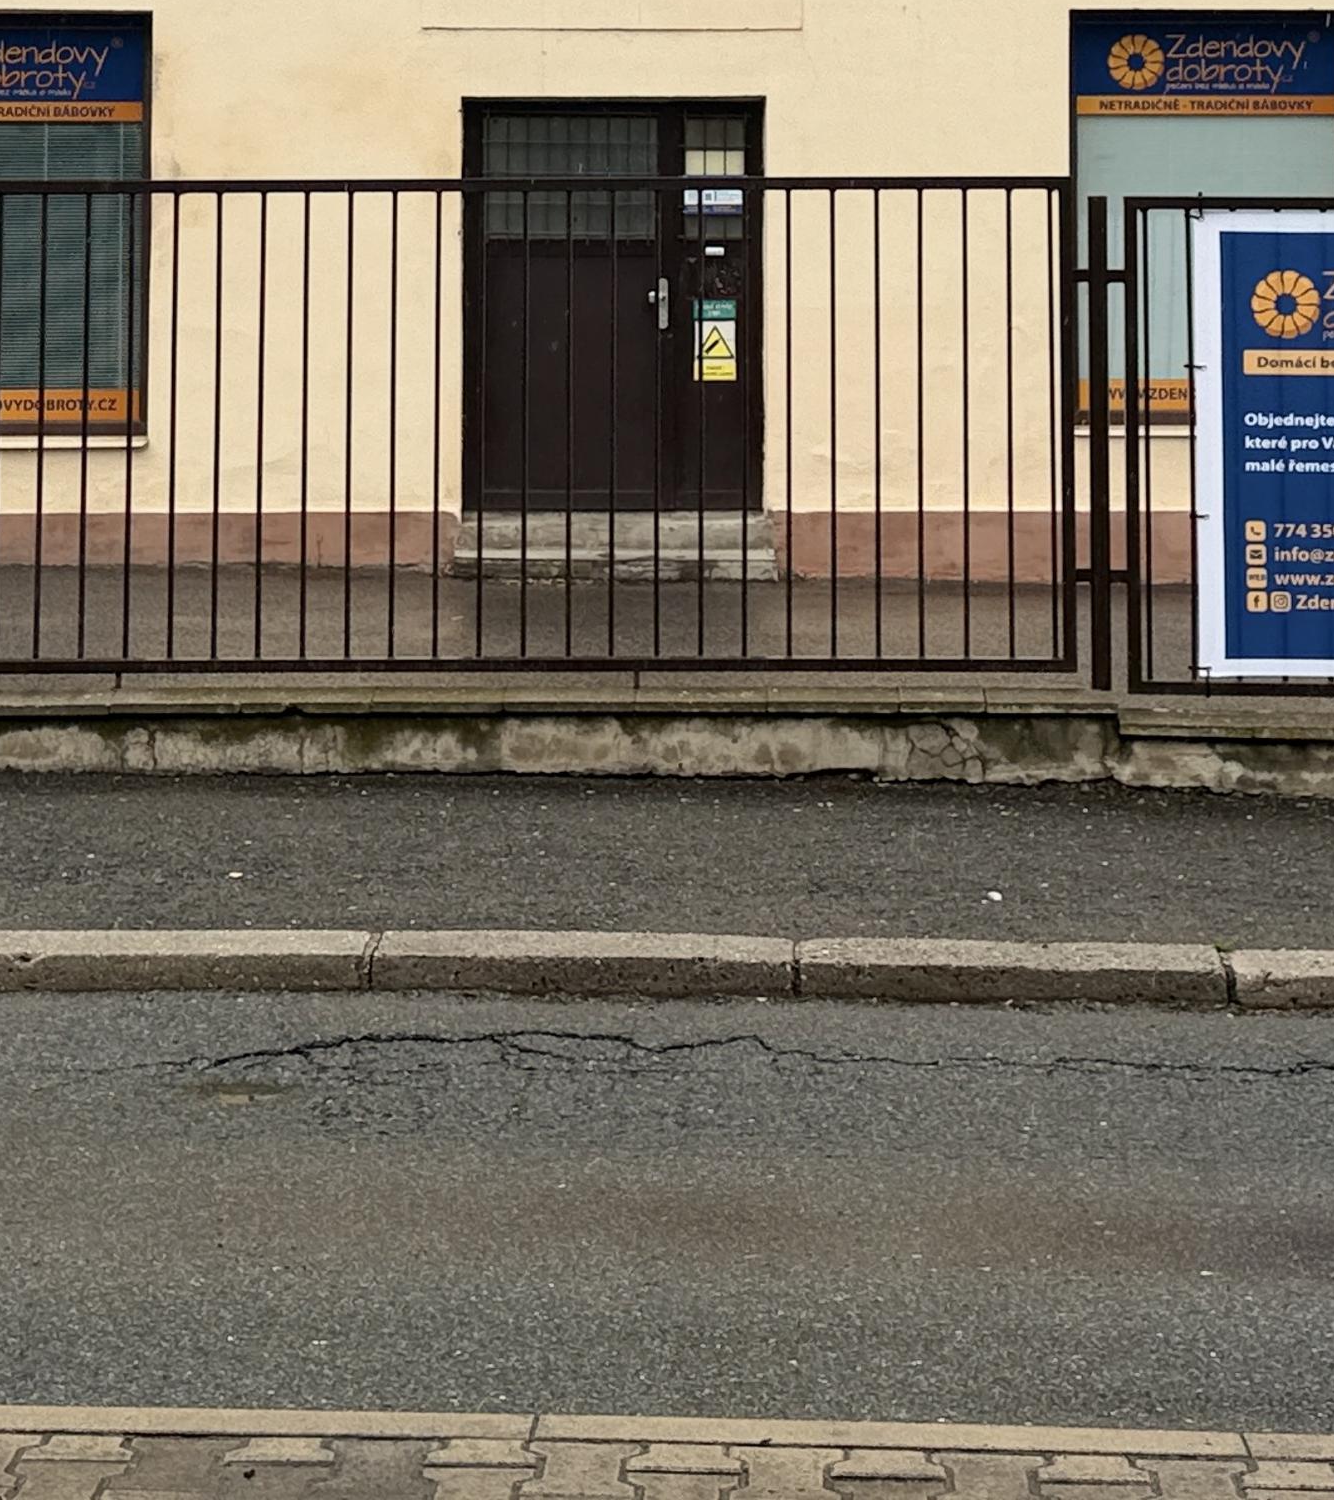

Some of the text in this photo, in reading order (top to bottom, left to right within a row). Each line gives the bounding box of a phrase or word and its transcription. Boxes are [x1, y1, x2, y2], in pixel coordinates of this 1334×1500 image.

[1165, 34, 1307, 70] Zdendovy
[1166, 58, 1284, 94] dobroty
[1256, 355, 1317, 369] Domácí
[1244, 435, 1288, 450] které
[1290, 439, 1319, 452] pro
[1244, 458, 1286, 473] malé
[1273, 523, 1308, 539] 774
